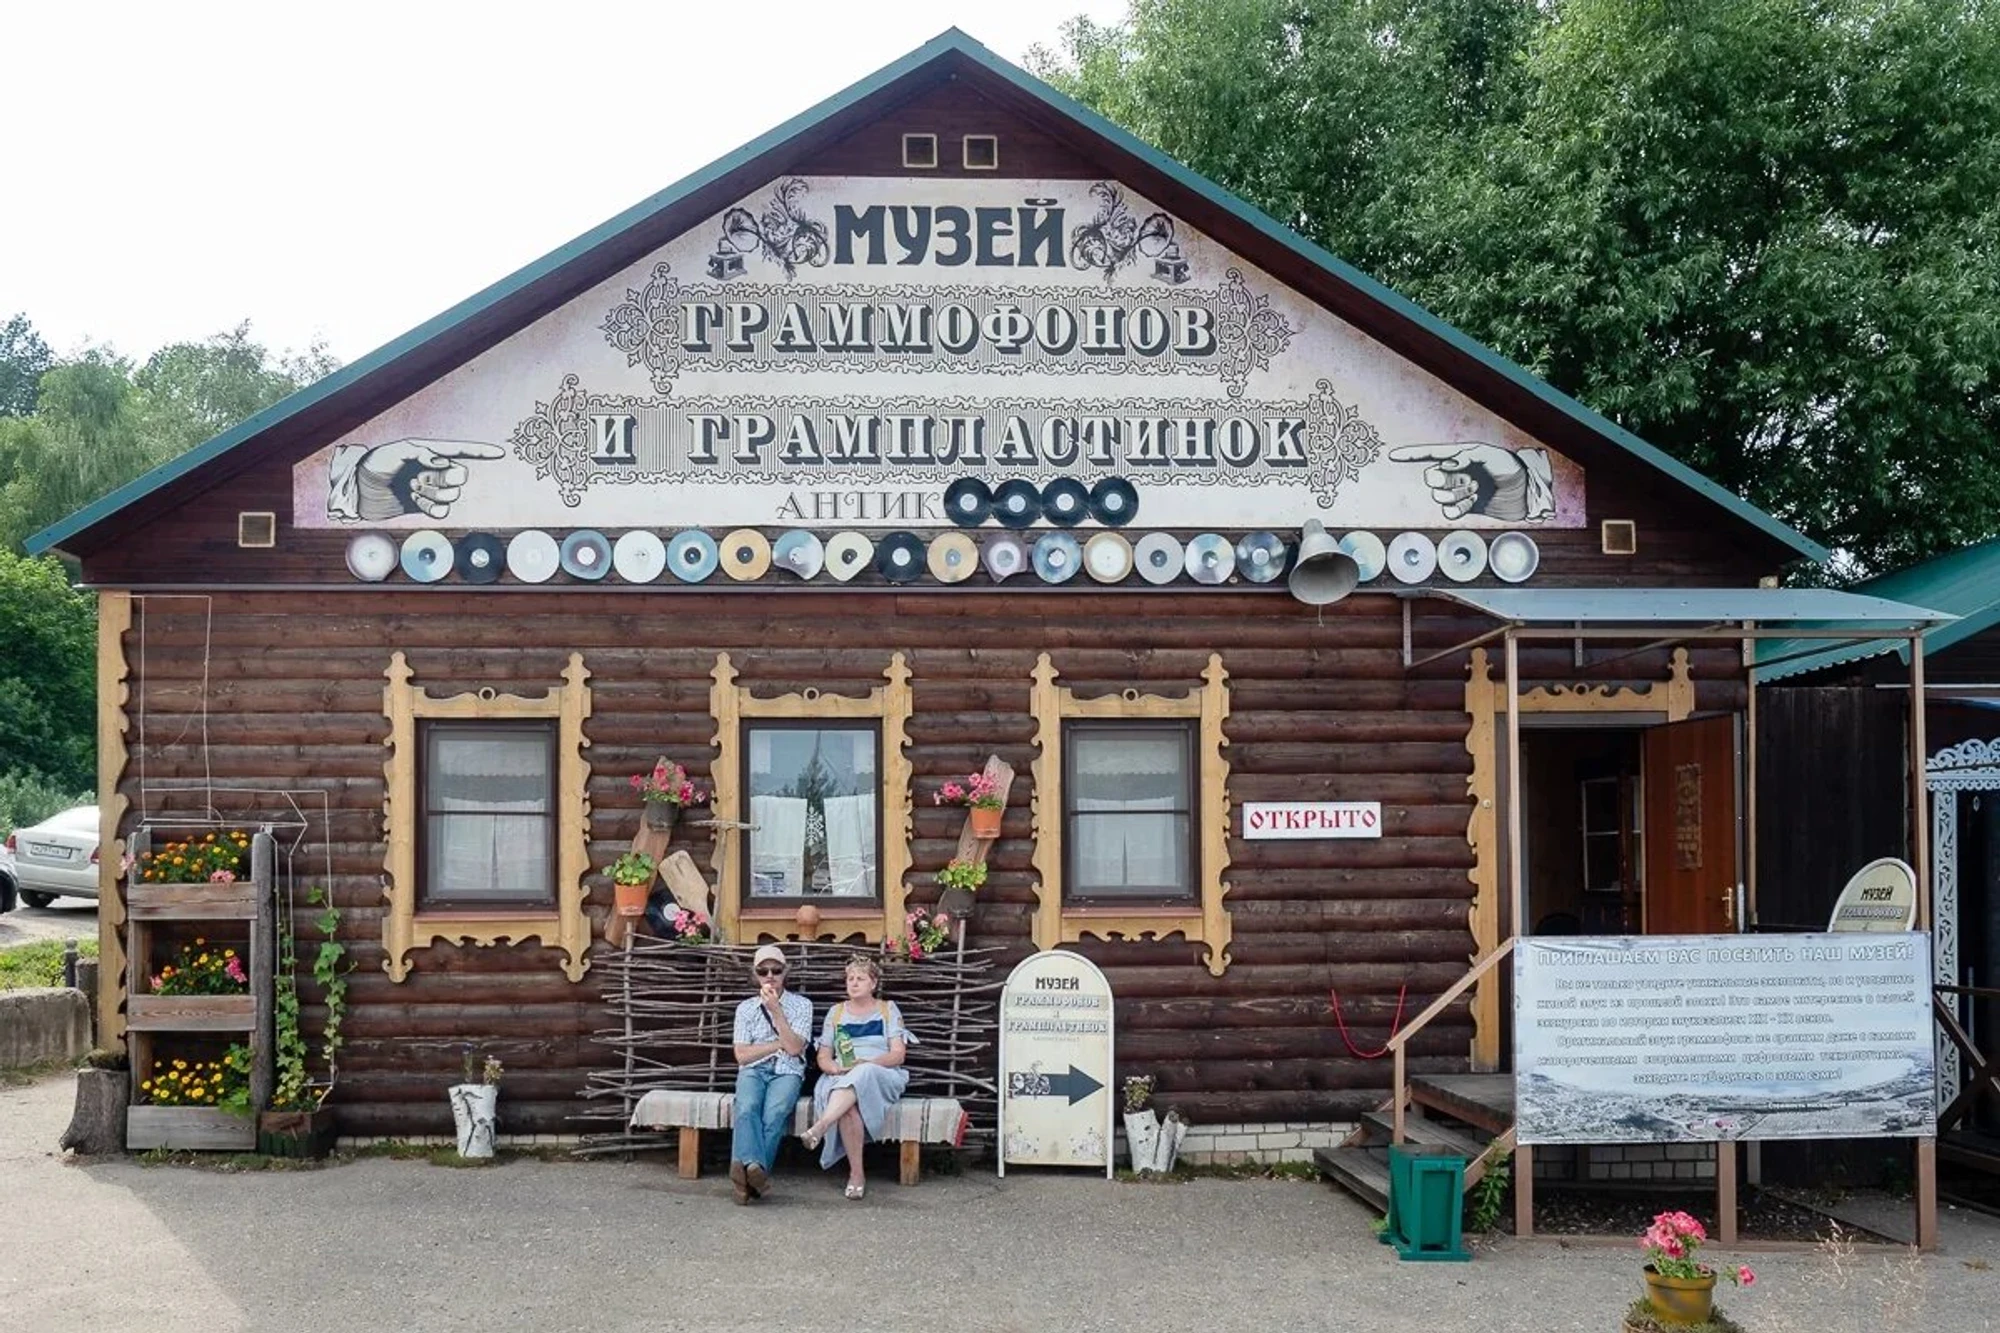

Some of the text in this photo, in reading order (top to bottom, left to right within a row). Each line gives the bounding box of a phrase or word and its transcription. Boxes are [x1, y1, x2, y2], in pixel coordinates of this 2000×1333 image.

[833, 199, 1067, 267] МУЗЕЙ
[680, 303, 1218, 356] ГРАММОФОНОВ
[588, 413, 1307, 466] И ГРАМПЛАСТИНОК
[775, 490, 946, 520] АНТИК
[1250, 810, 1376, 829] ОТКРЫТО
[1538, 942, 1915, 965] ПРИГЛАШАЕМ ВАС ПОСЕТИТЬ НАШ МУЗЕЙ!
[1035, 976, 1080, 989] МУЗЕЙ
